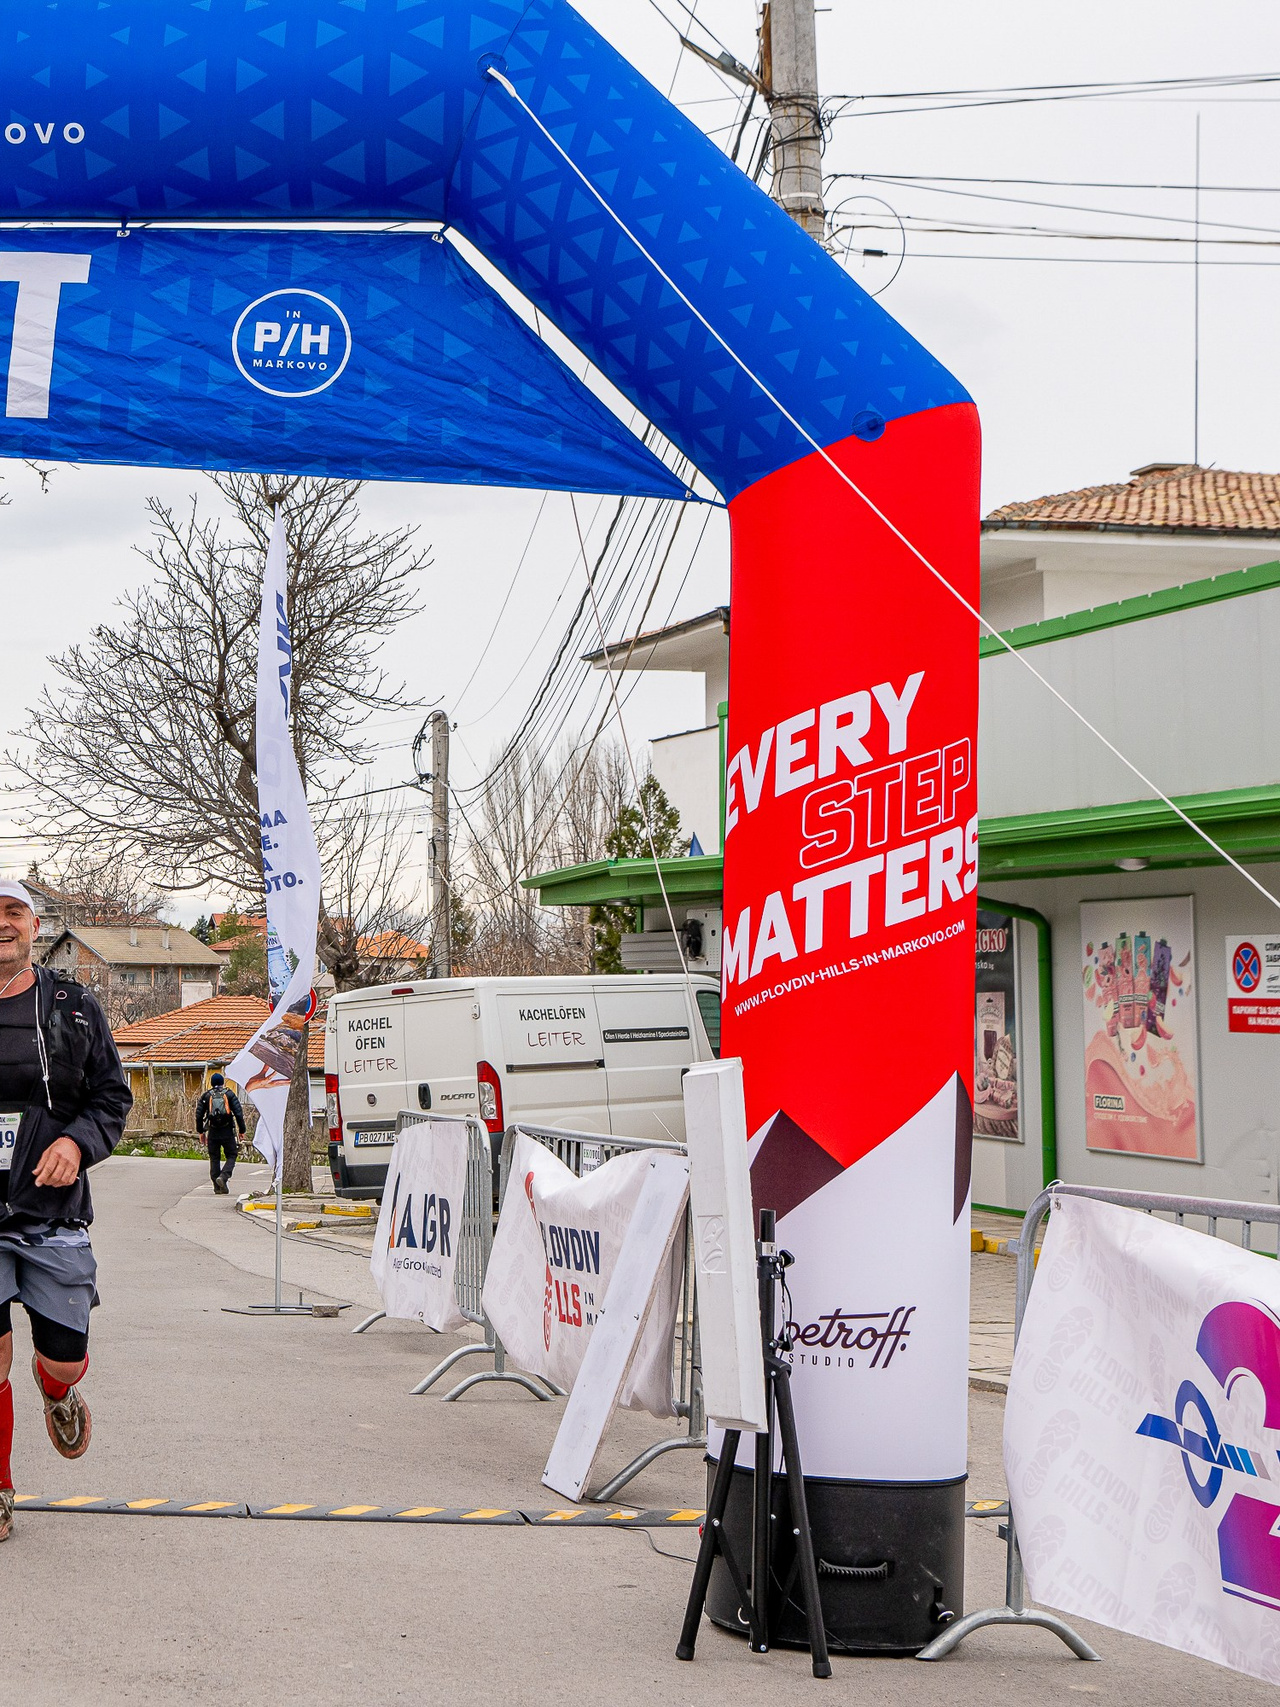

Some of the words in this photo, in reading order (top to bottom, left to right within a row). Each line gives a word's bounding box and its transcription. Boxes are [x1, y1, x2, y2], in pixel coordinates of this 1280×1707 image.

[285, 310, 301, 319] IN
[253, 321, 330, 357] P/H
[252, 358, 328, 371] MARKOVO
[725, 670, 926, 841] EVERY
[799, 737, 971, 870] STEP
[722, 812, 979, 1004] MATTERS
[734, 919, 966, 1017] WWW.PLOVDIV-HILLS-IN-MARKOVO.COM
[519, 1005, 586, 1021] KACHELÖFEN
[348, 1016, 392, 1032] KACHEL
[355, 1035, 385, 1050] ÖFEN
[527, 1031, 586, 1047] LEITER
[344, 1058, 398, 1074] LEITER
[440, 1092, 476, 1101] DUCATO
[1095, 1095, 1124, 1111] FLORINA
[584, 1291, 595, 1306] IN
[788, 1353, 854, 1368] STUDIO
